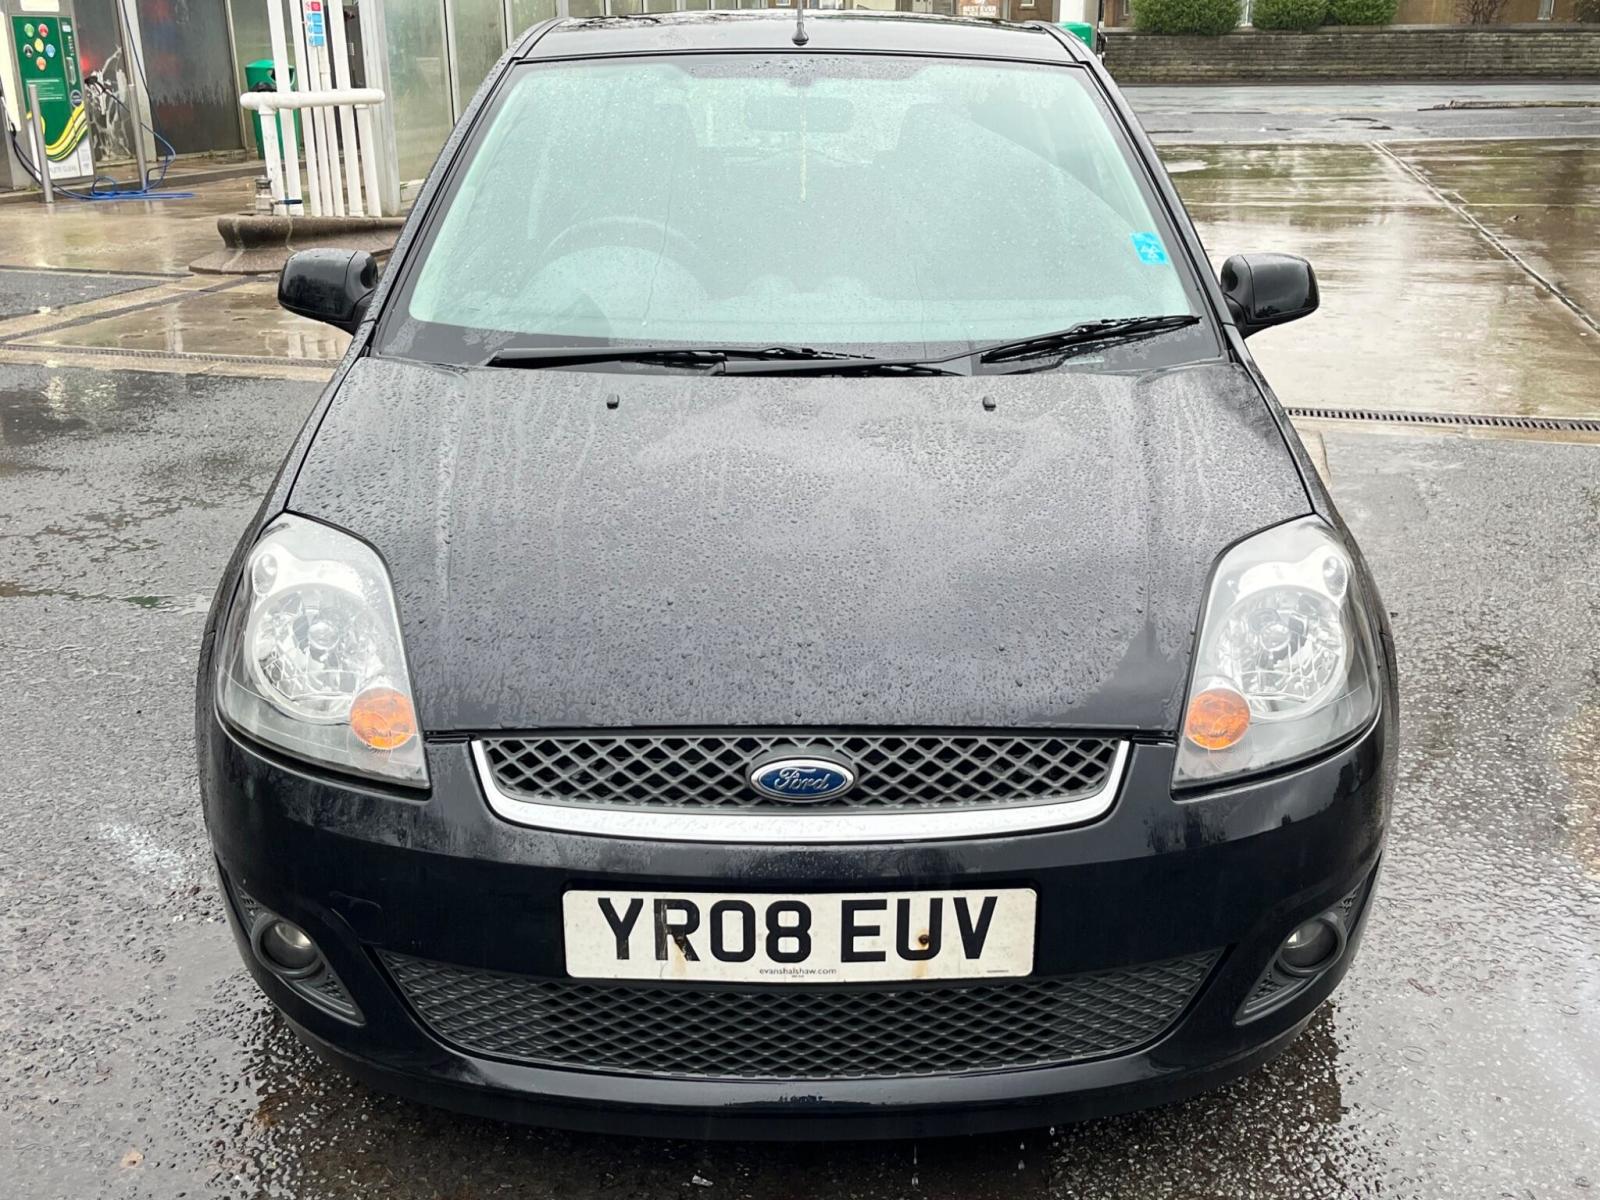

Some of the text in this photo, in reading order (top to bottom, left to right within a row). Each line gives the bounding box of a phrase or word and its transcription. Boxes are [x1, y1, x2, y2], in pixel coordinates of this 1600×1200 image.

[774, 767, 830, 790] Ford
[598, 896, 998, 963] YR08 EUV
[759, 967, 837, 975] evanshalshaw.com
